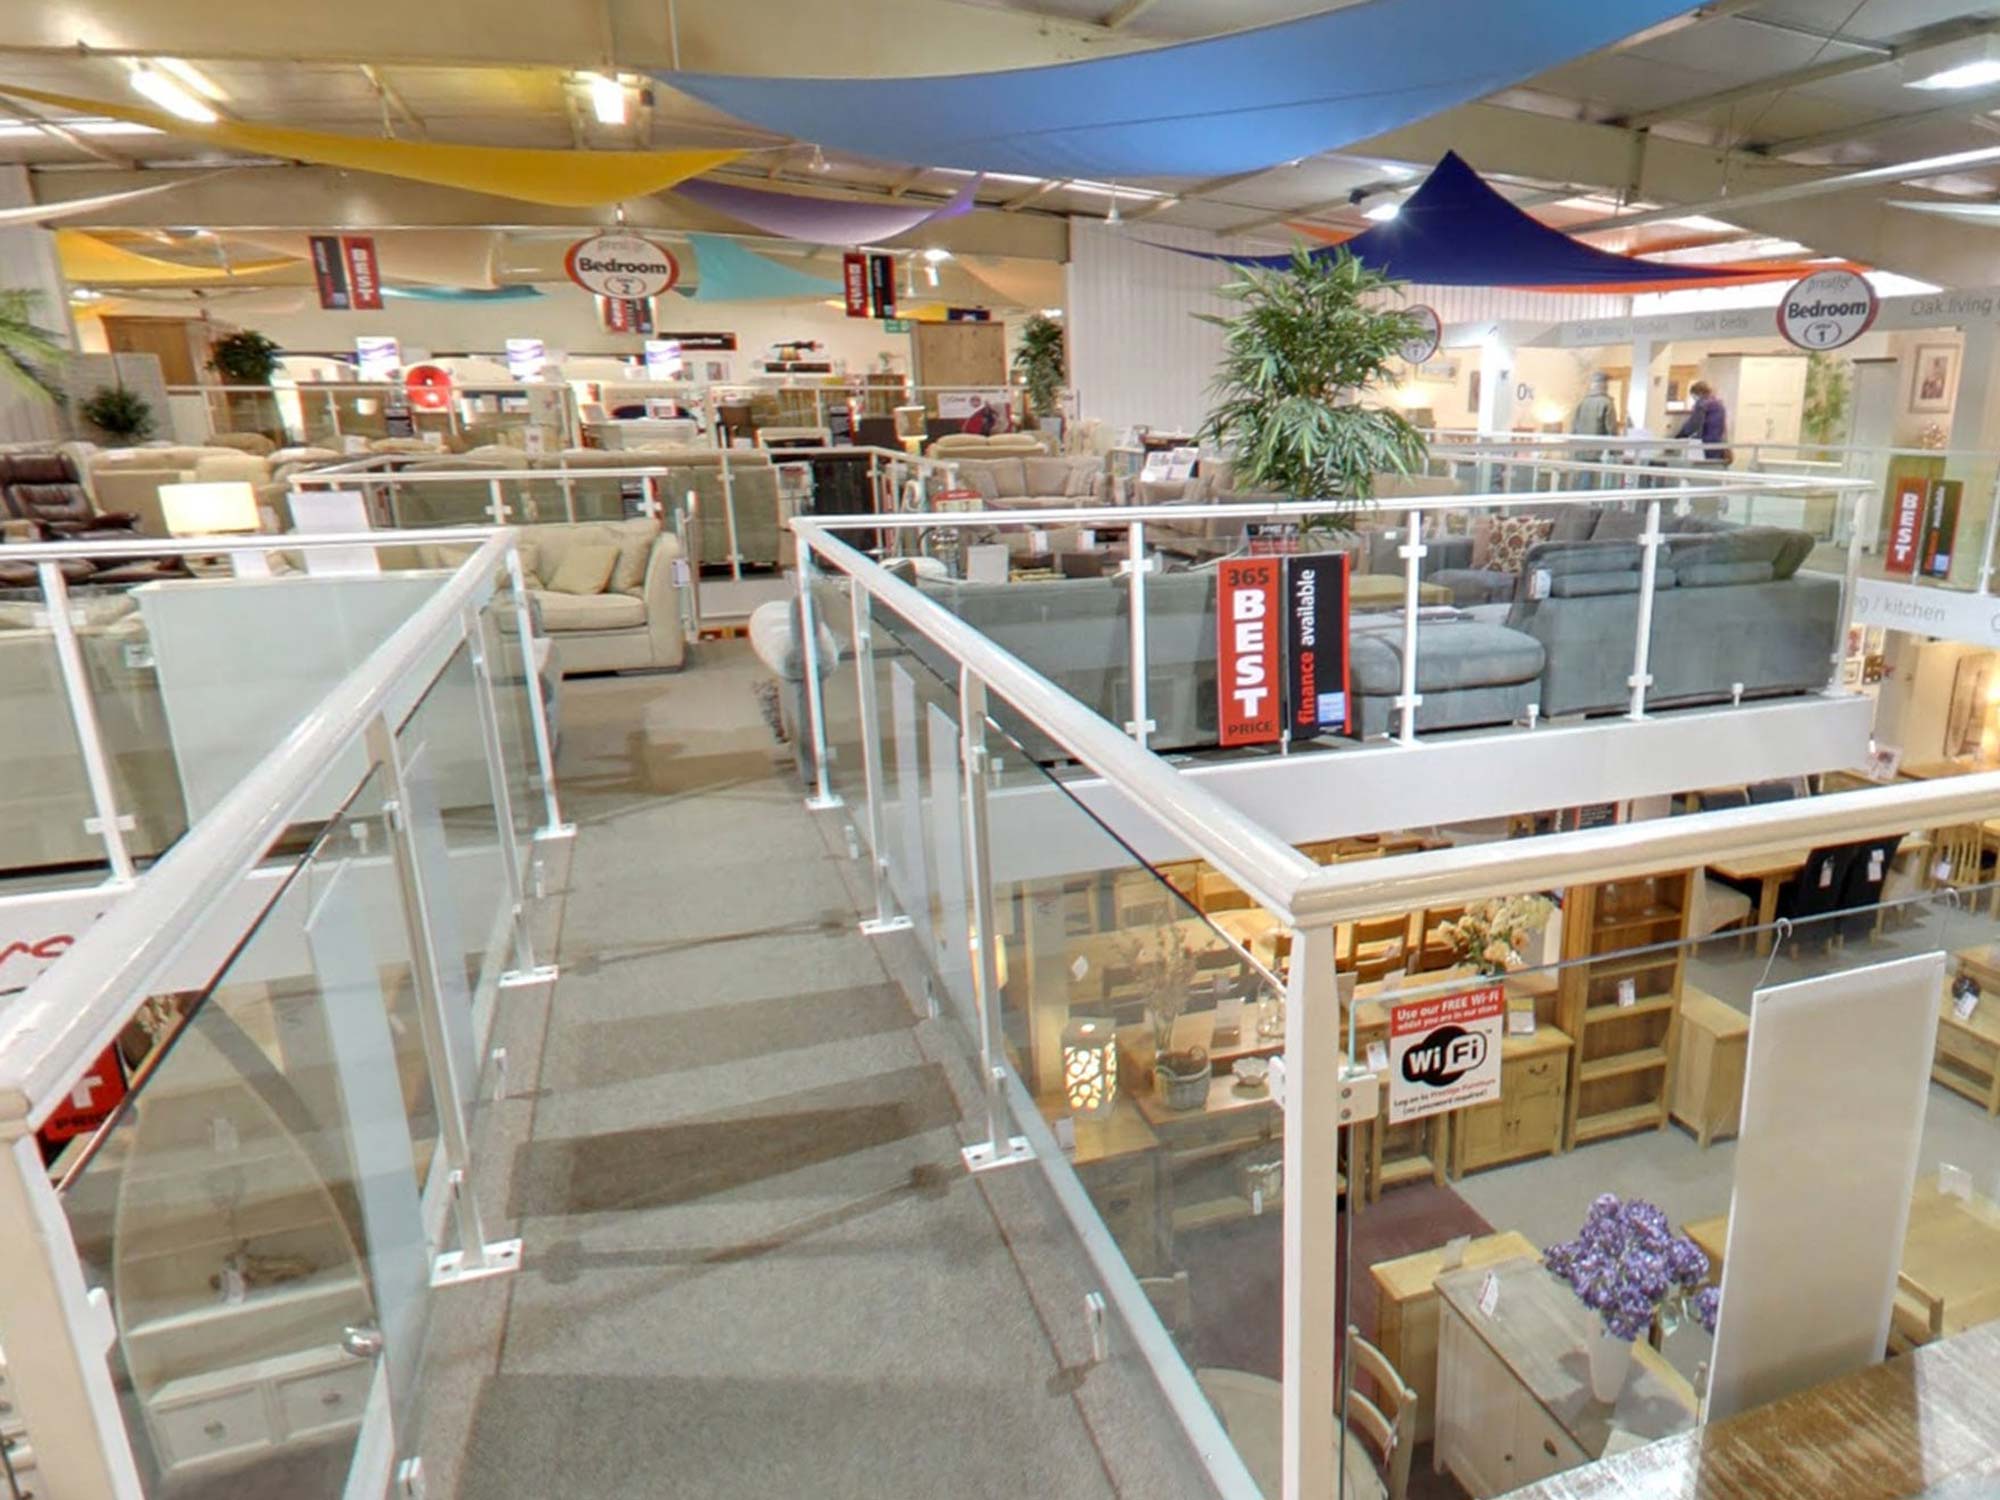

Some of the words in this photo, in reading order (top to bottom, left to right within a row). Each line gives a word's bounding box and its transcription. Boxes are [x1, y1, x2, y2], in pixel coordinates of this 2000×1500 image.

[578, 257, 667, 275] Bedroom
[622, 283, 631, 295] 2
[1787, 300, 1867, 319] Bedroom
[1894, 491, 1919, 562] BEST
[1227, 567, 1270, 587] 365
[1296, 568, 1316, 647] available
[1885, 598, 1946, 622] kitchen
[1232, 587, 1269, 719] BEST
[1297, 651, 1316, 726] finance
[1228, 720, 1273, 736] PRICE
[1397, 1009, 1418, 1021] Use
[1420, 1005, 1440, 1017] our
[1442, 997, 1468, 1013] FREE
[1471, 989, 1499, 1006] Wi-Fi
